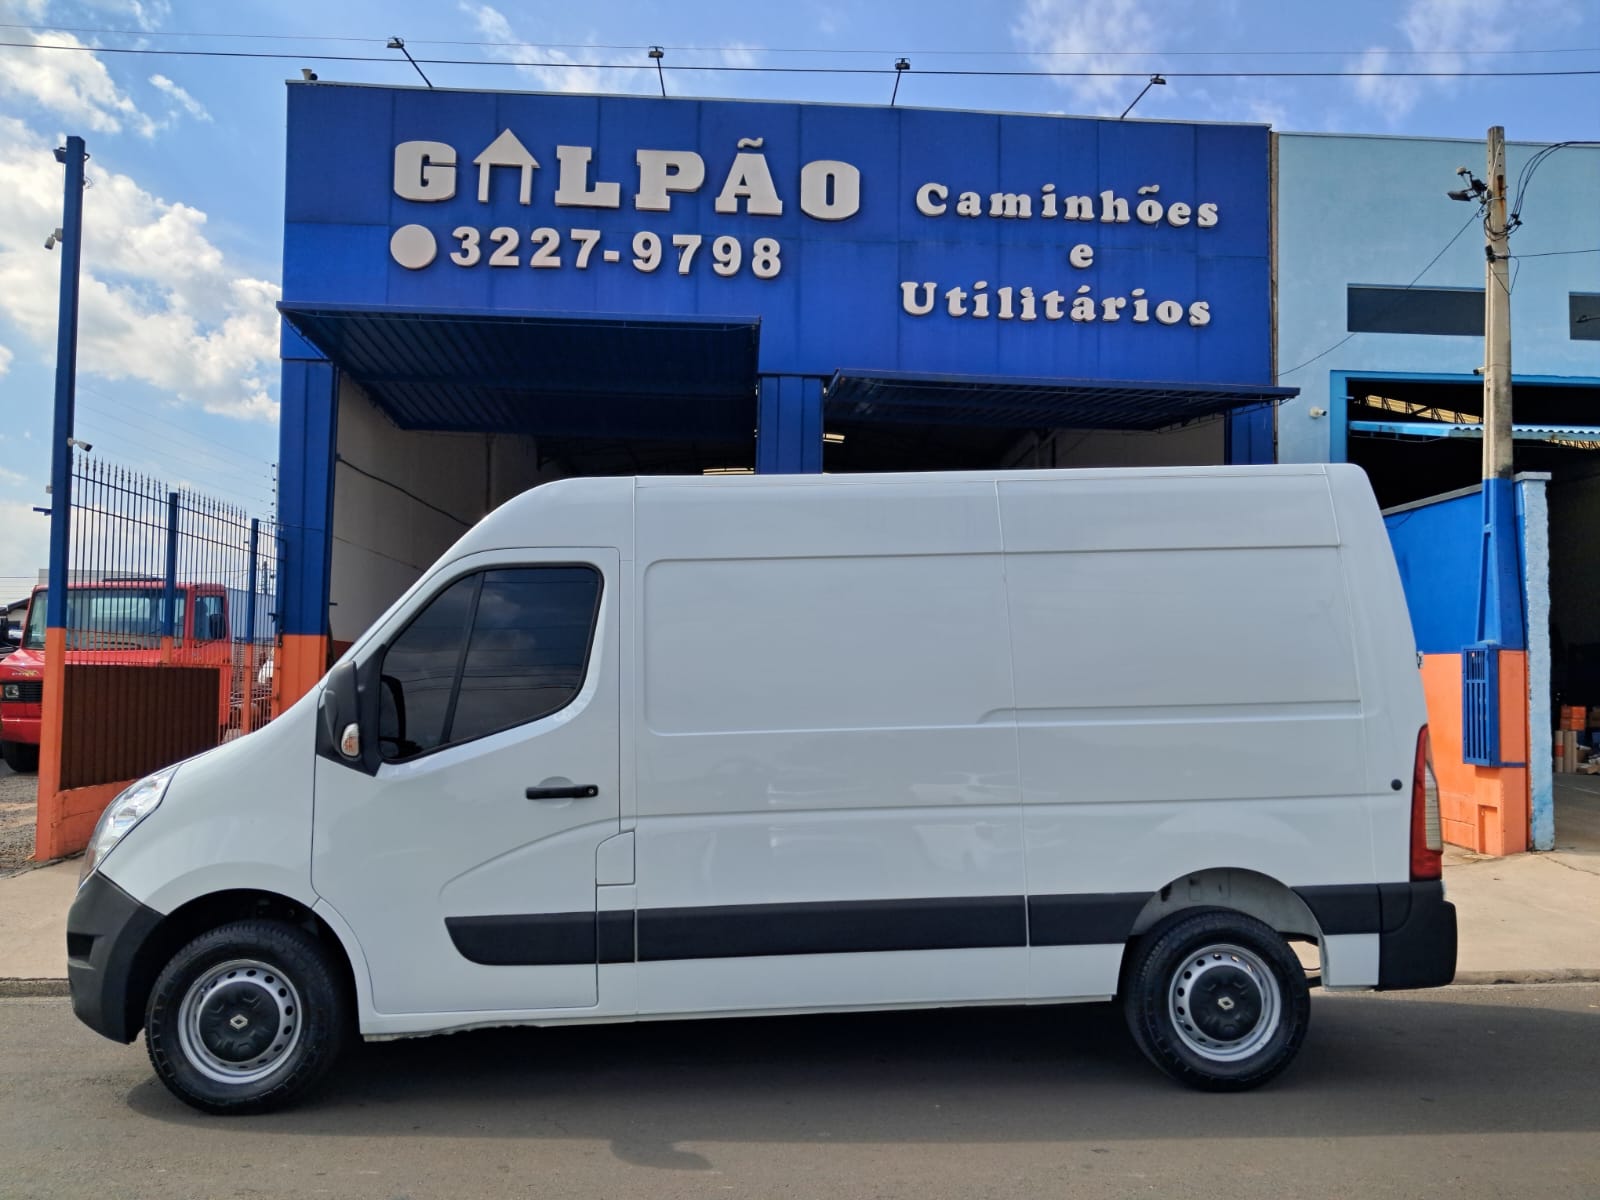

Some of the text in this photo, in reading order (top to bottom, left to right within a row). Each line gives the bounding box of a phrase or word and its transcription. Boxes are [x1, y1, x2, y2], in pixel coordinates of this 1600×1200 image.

[915, 182, 1219, 228] Caminhões
[449, 226, 781, 280] 3227-9798
[1069, 243, 1094, 269] e
[900, 280, 1211, 326] Utilitários
